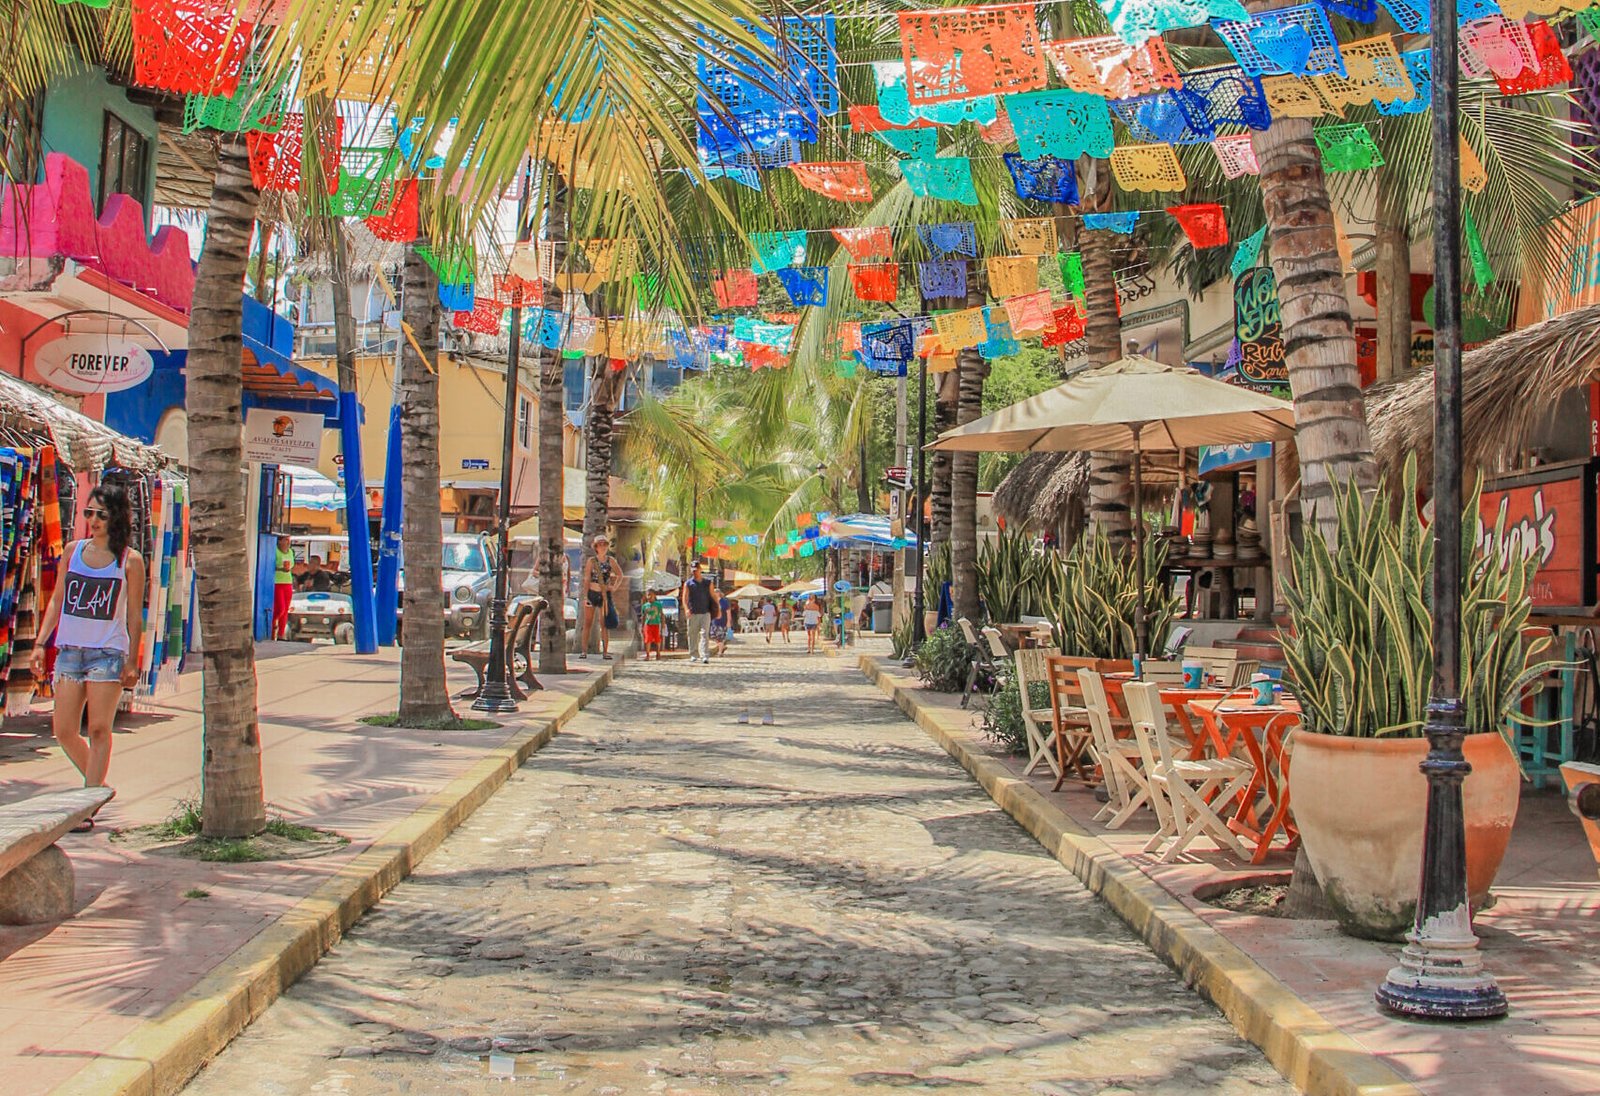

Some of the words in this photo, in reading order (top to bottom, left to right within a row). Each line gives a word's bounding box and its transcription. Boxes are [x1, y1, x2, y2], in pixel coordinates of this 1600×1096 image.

[71, 353, 129, 372] FOREVER
[1241, 342, 1285, 363] Rub
[67, 580, 116, 616] GLAM
